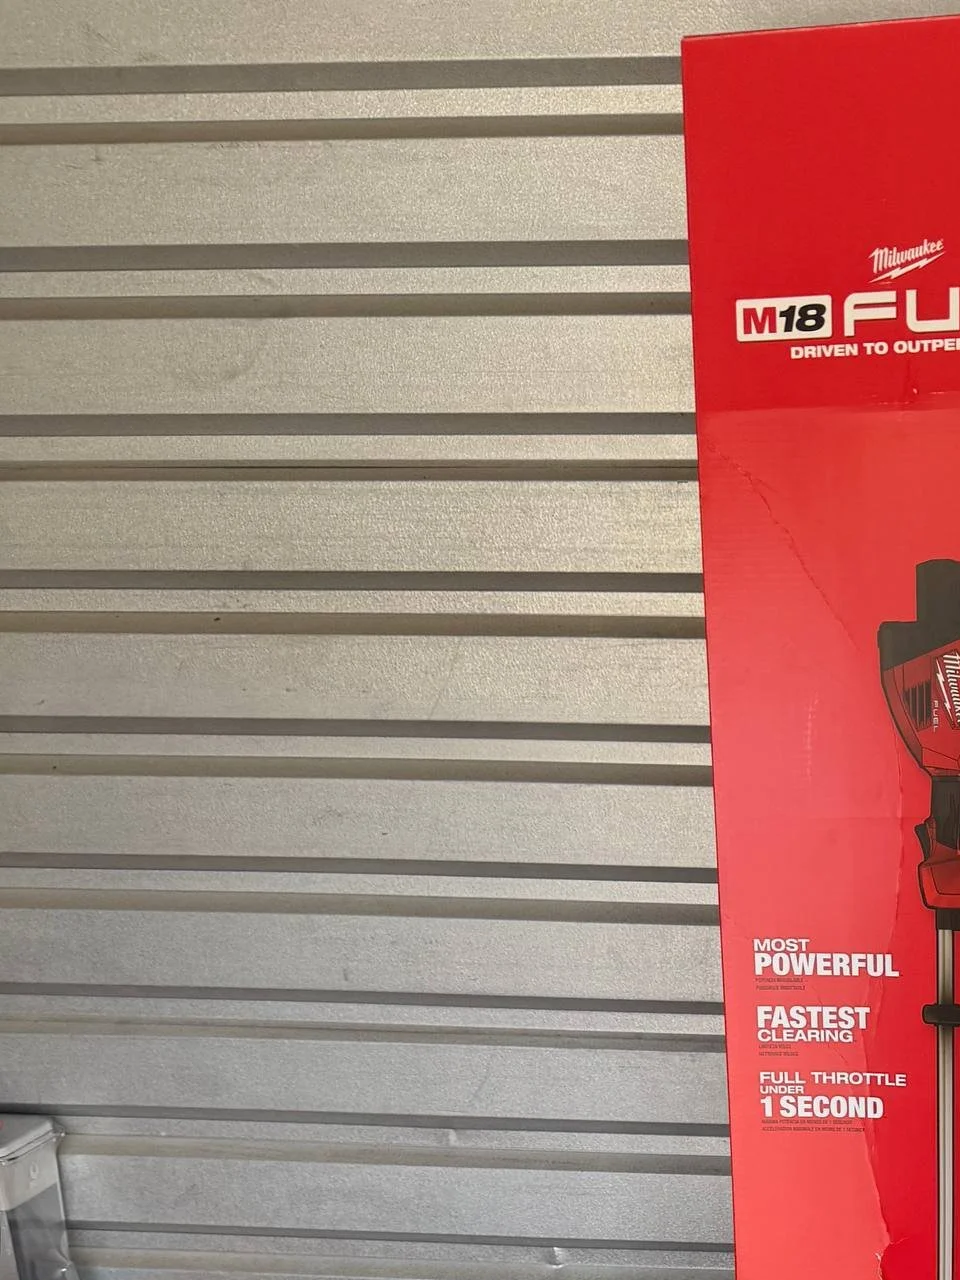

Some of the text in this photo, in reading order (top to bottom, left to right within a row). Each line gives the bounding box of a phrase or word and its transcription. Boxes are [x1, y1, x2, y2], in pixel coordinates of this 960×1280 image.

[868, 239, 943, 273] Milwaukee
[742, 304, 827, 335] M18
[790, 342, 859, 360] DRIVEN
[863, 341, 888, 356] TO
[753, 938, 810, 952] MOST
[754, 952, 900, 977] POWERFUL
[756, 1006, 870, 1029] FASTEST
[757, 1030, 854, 1042] CLEARING
[760, 1071, 907, 1087] FULL THROTTLE
[760, 1085, 805, 1094] UNDER
[760, 1096, 884, 1119] 1 SECOND
